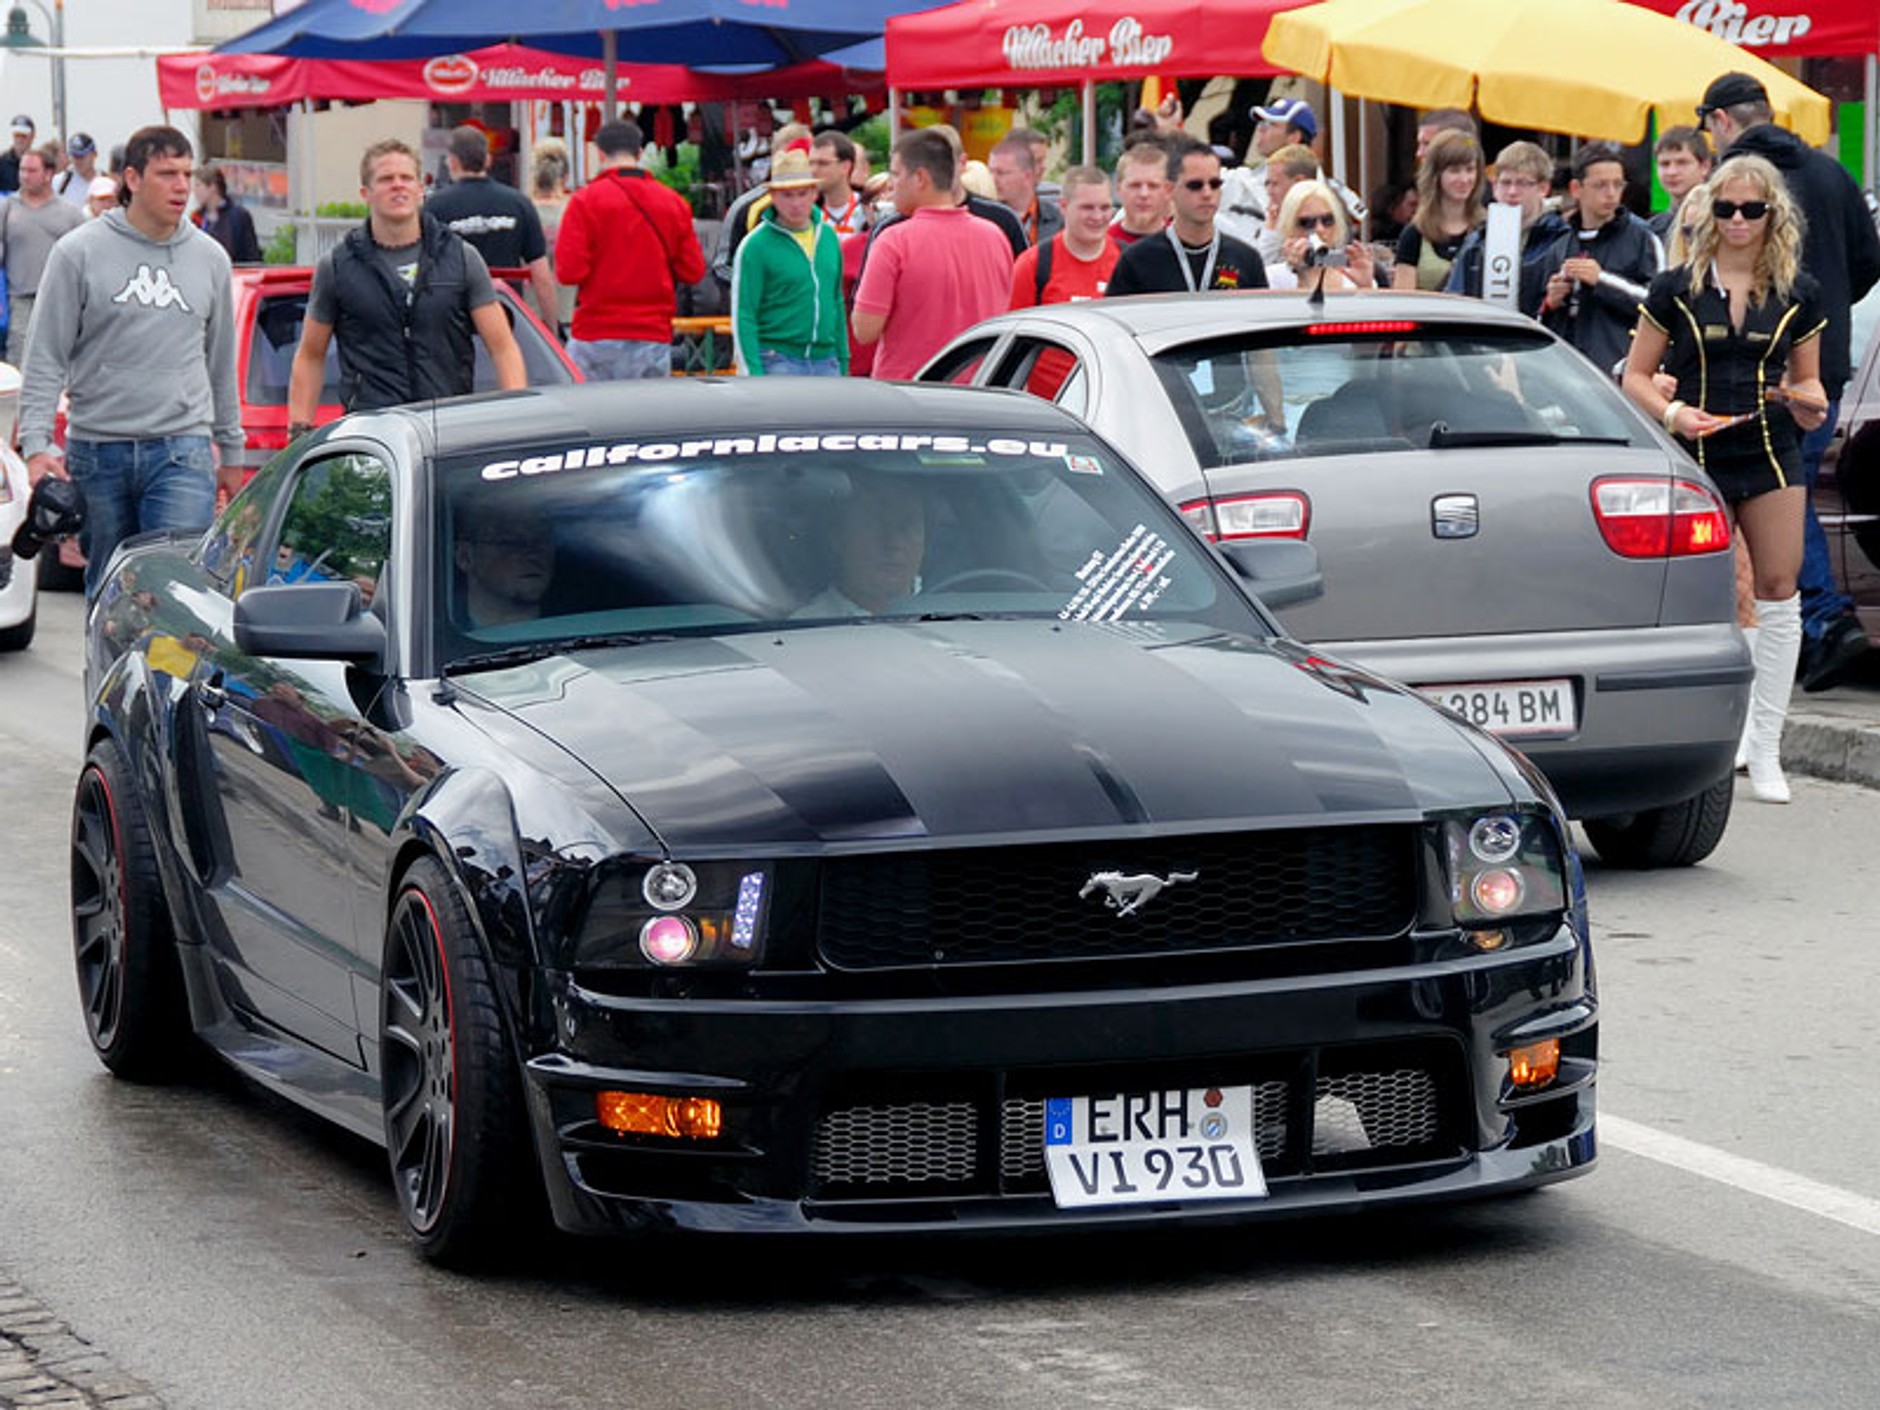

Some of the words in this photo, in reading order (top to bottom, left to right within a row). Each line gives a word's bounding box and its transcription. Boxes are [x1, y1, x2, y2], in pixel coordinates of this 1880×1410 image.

[1109, 16, 1172, 66] Bier
[579, 69, 631, 91] Bir
[1490, 255, 1512, 299] GTI
[481, 434, 1068, 481] californiacars.eu
[1450, 691, 1509, 726] 384
[1518, 688, 1562, 723] BM
[1053, 1123, 1066, 1139] D
[1088, 1089, 1189, 1143] ERH
[1068, 1151, 1138, 1195] VI
[1144, 1144, 1245, 1190] 930
